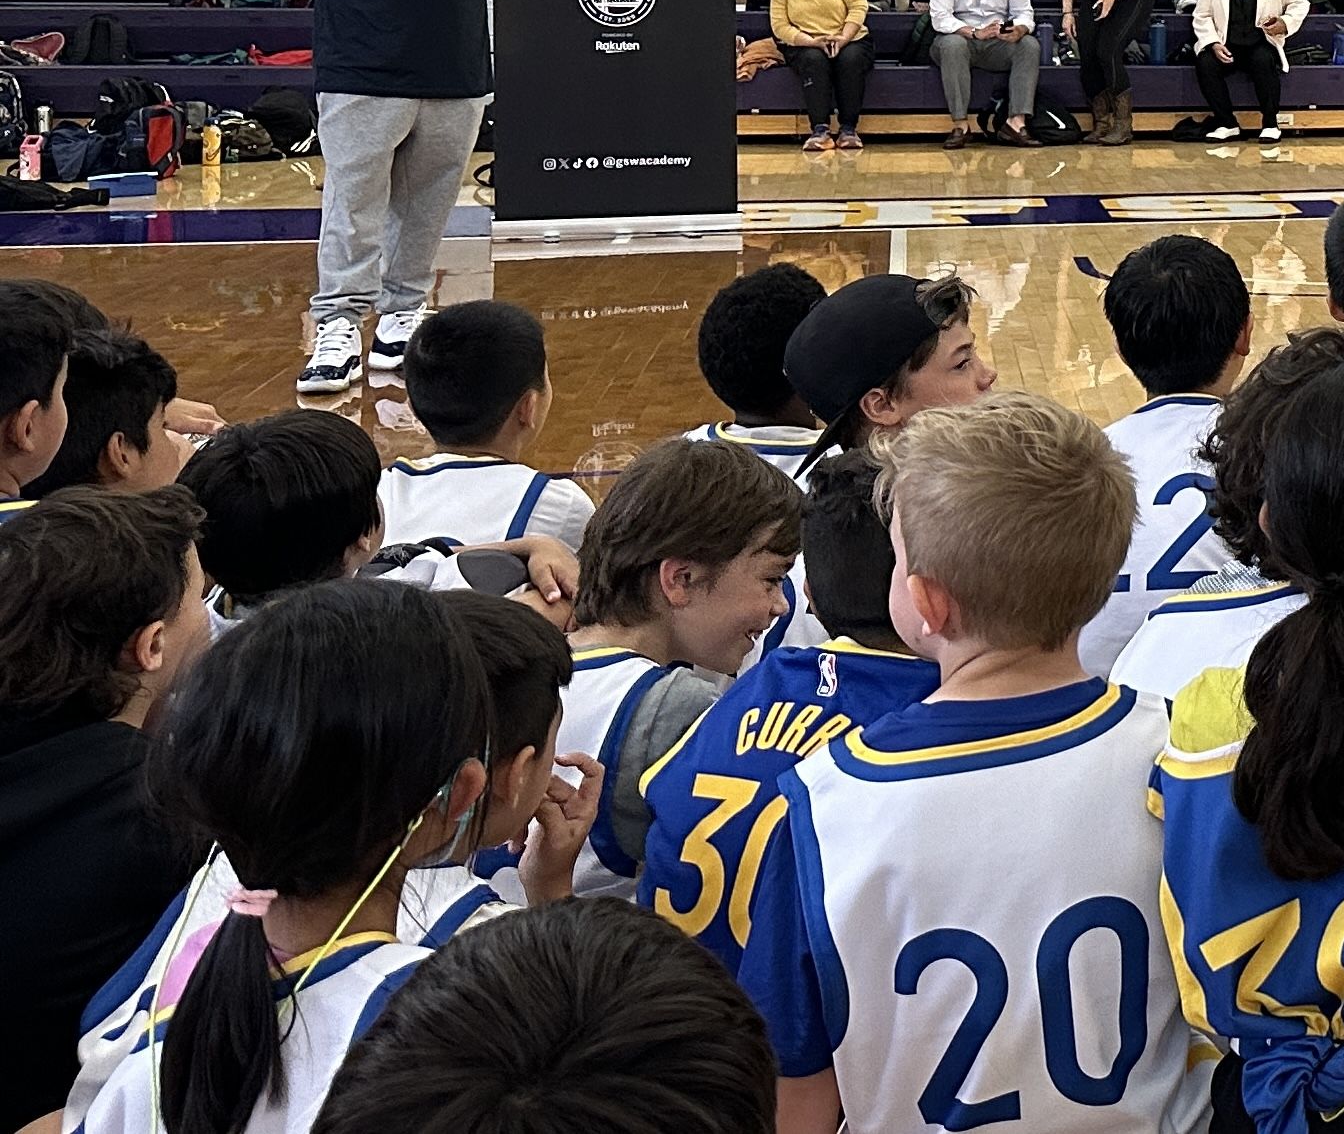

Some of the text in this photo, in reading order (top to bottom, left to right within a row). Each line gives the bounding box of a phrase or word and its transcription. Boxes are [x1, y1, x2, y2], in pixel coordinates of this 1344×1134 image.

[595, 40, 640, 53] Rakuten
[602, 154, 692, 169] @gswacademy
[1112, 471, 1226, 594] 2
[736, 702, 852, 758] CURR
[894, 878, 1150, 1132] 20
